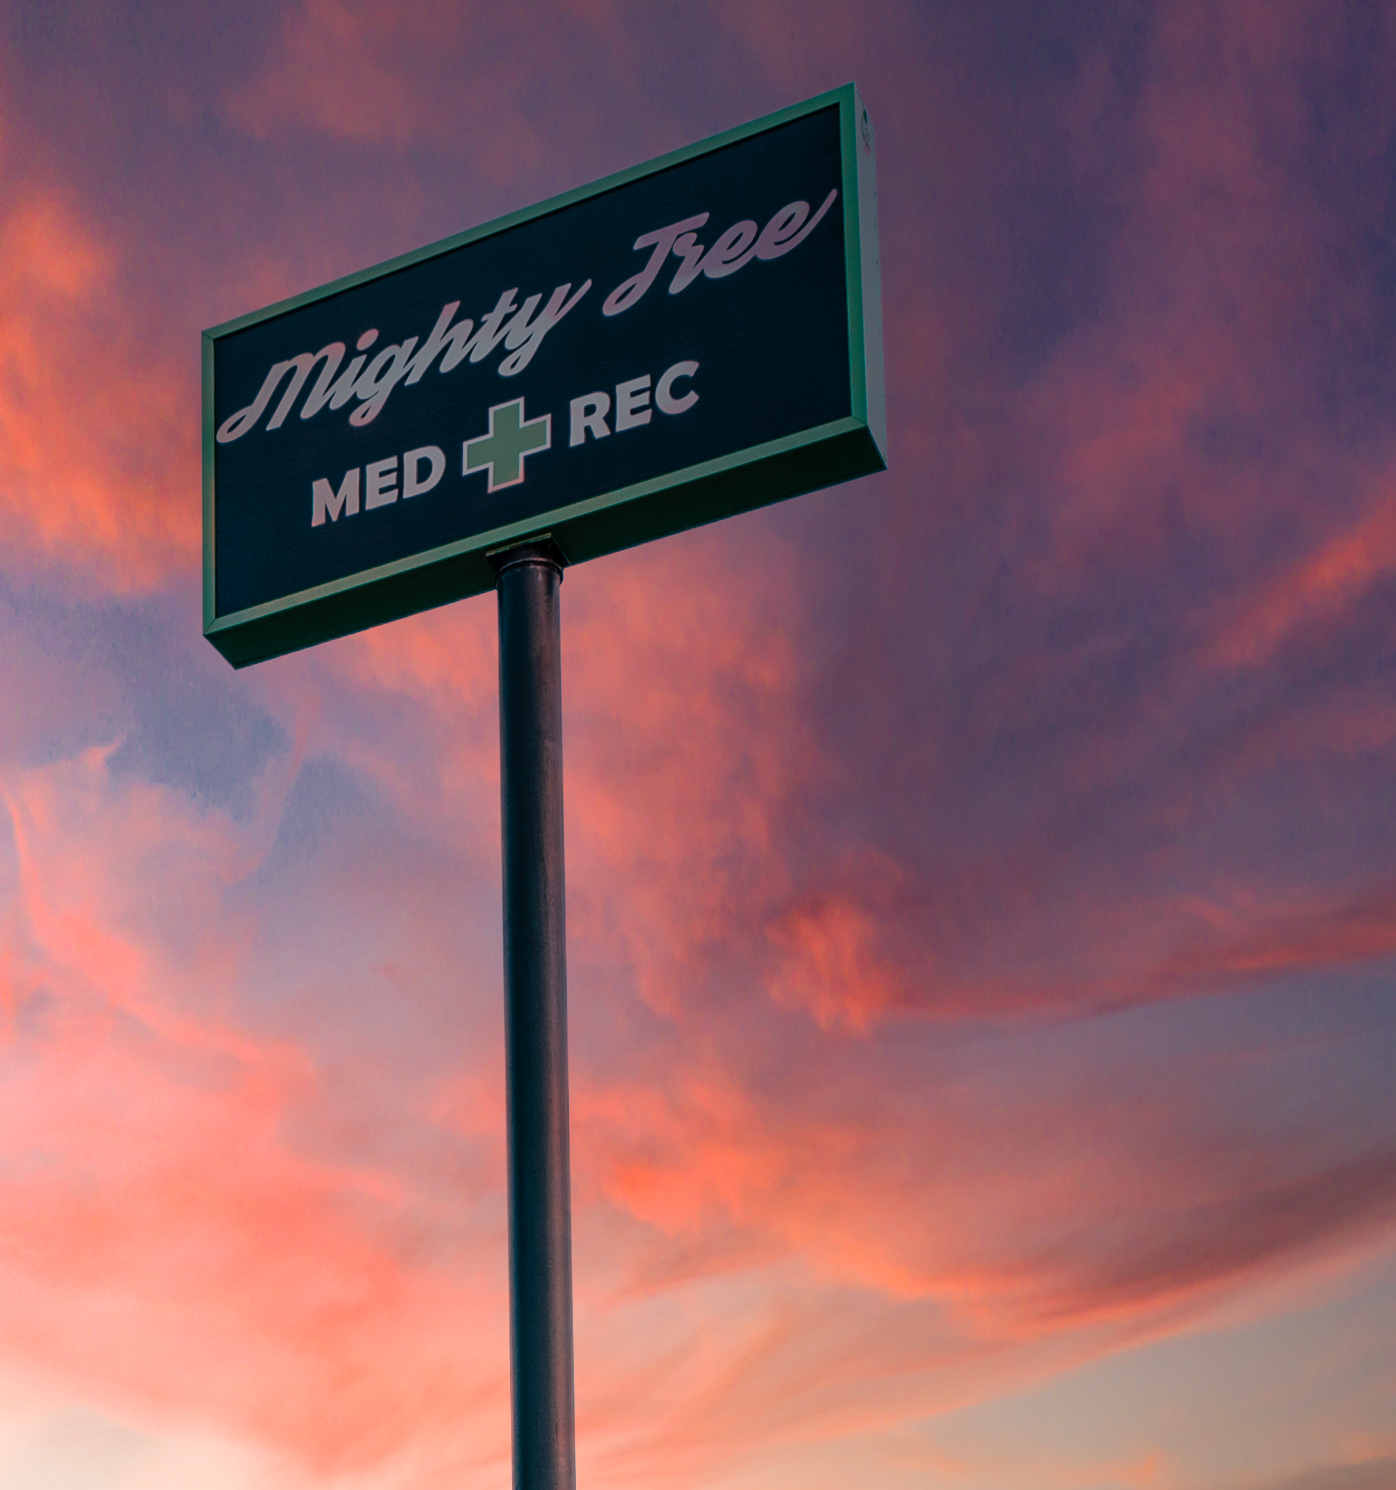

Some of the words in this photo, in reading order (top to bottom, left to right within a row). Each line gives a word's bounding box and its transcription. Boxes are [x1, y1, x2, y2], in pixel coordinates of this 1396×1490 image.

[216, 279, 592, 444] Mighty
[602, 188, 838, 317] Tree
[311, 445, 447, 528] MED
[569, 360, 700, 448] REC
